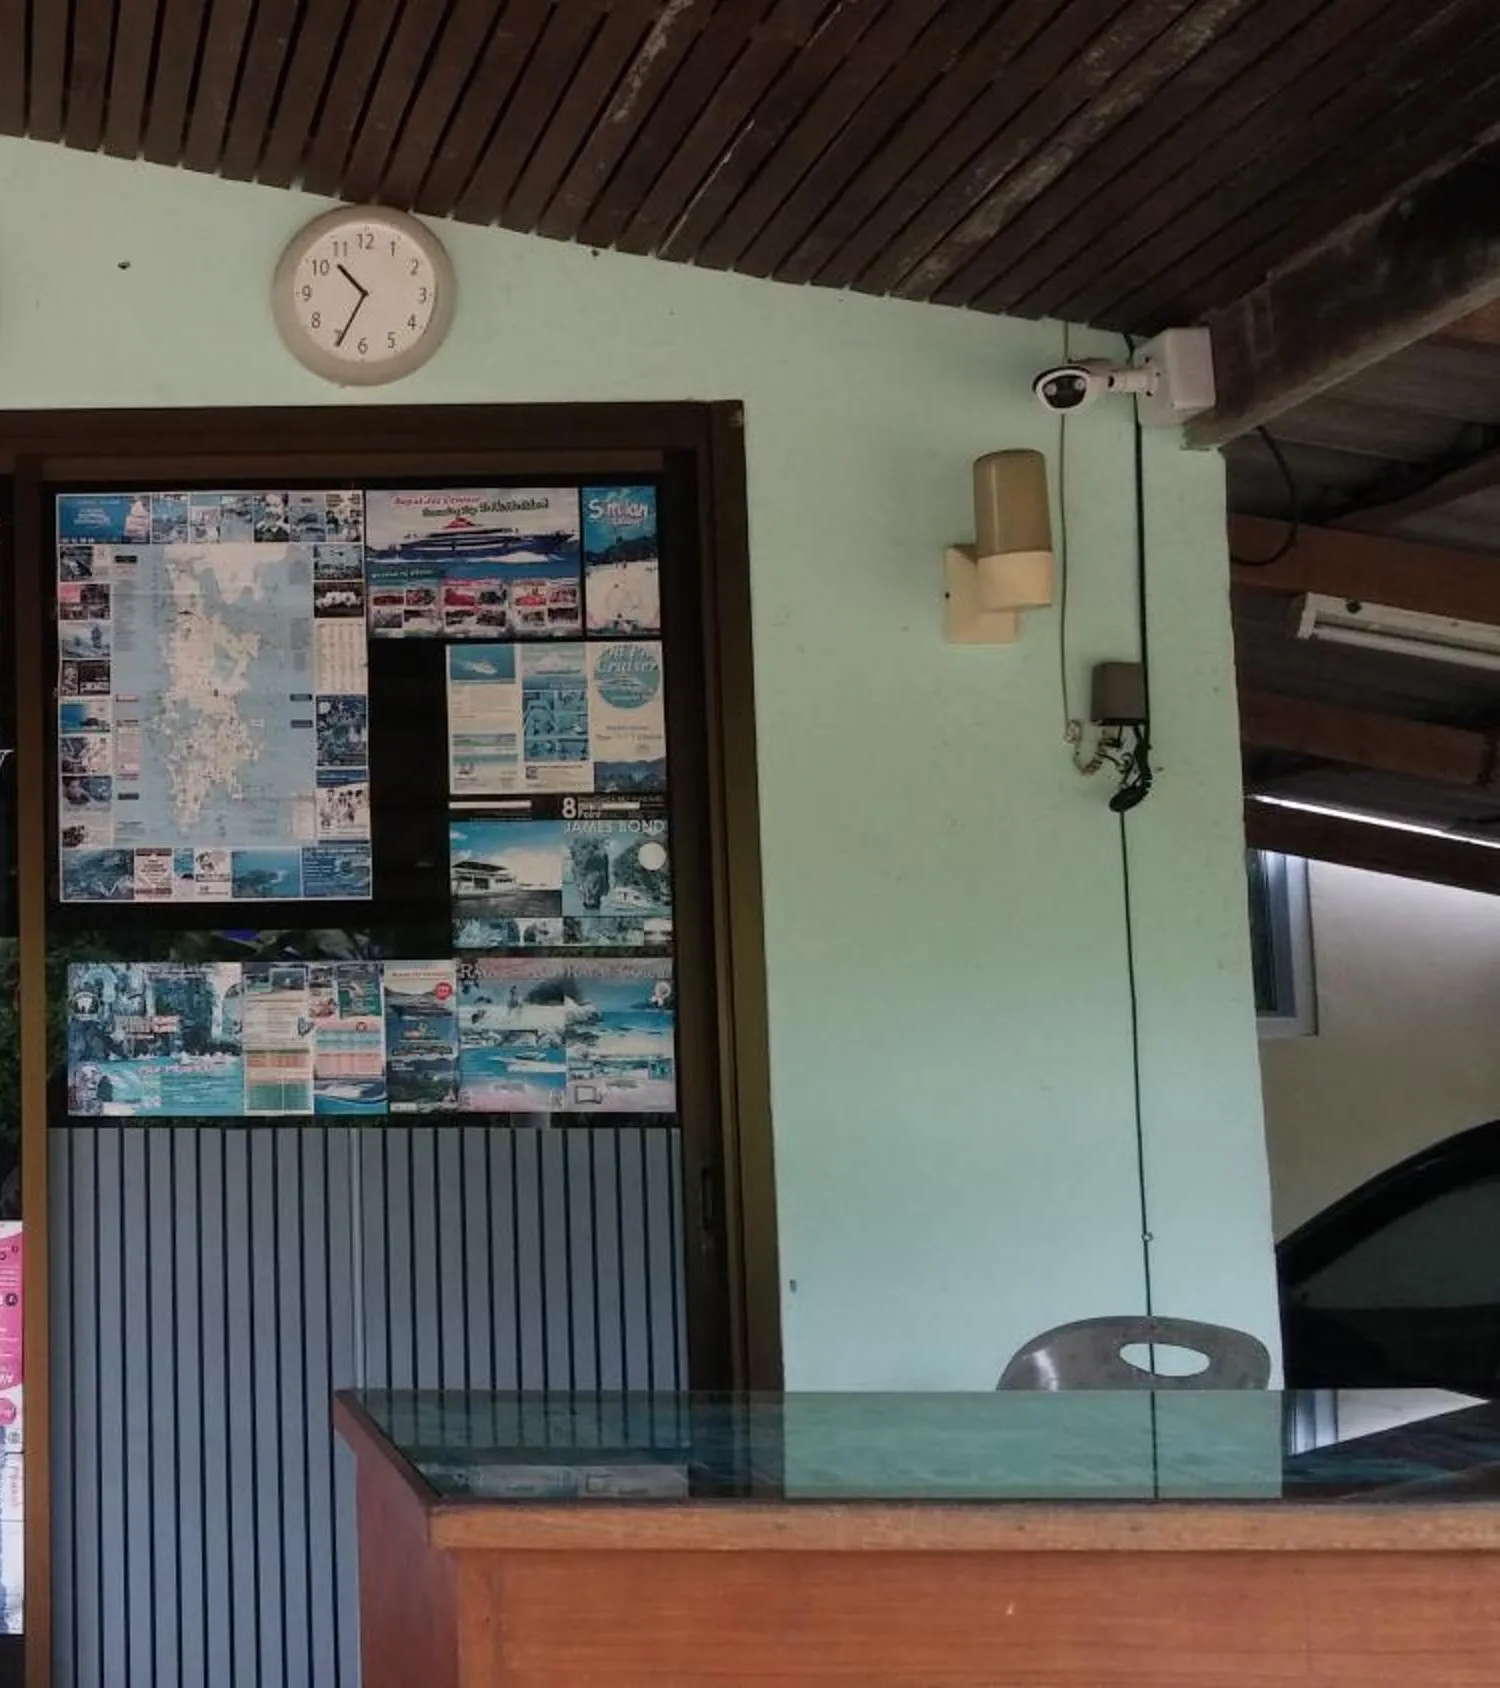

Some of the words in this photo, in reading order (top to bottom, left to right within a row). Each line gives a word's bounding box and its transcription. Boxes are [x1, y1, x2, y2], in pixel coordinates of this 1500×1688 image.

[332, 240, 348, 257] 11
[356, 233, 374, 250] 12
[311, 259, 330, 276] 10
[410, 258, 419, 275] 2
[301, 284, 312, 302] 9
[419, 286, 427, 304] 3
[311, 311, 321, 328] 8
[407, 313, 416, 331] 4
[357, 336, 368, 354] 6
[387, 331, 396, 349] 5
[562, 797, 577, 819] 8
